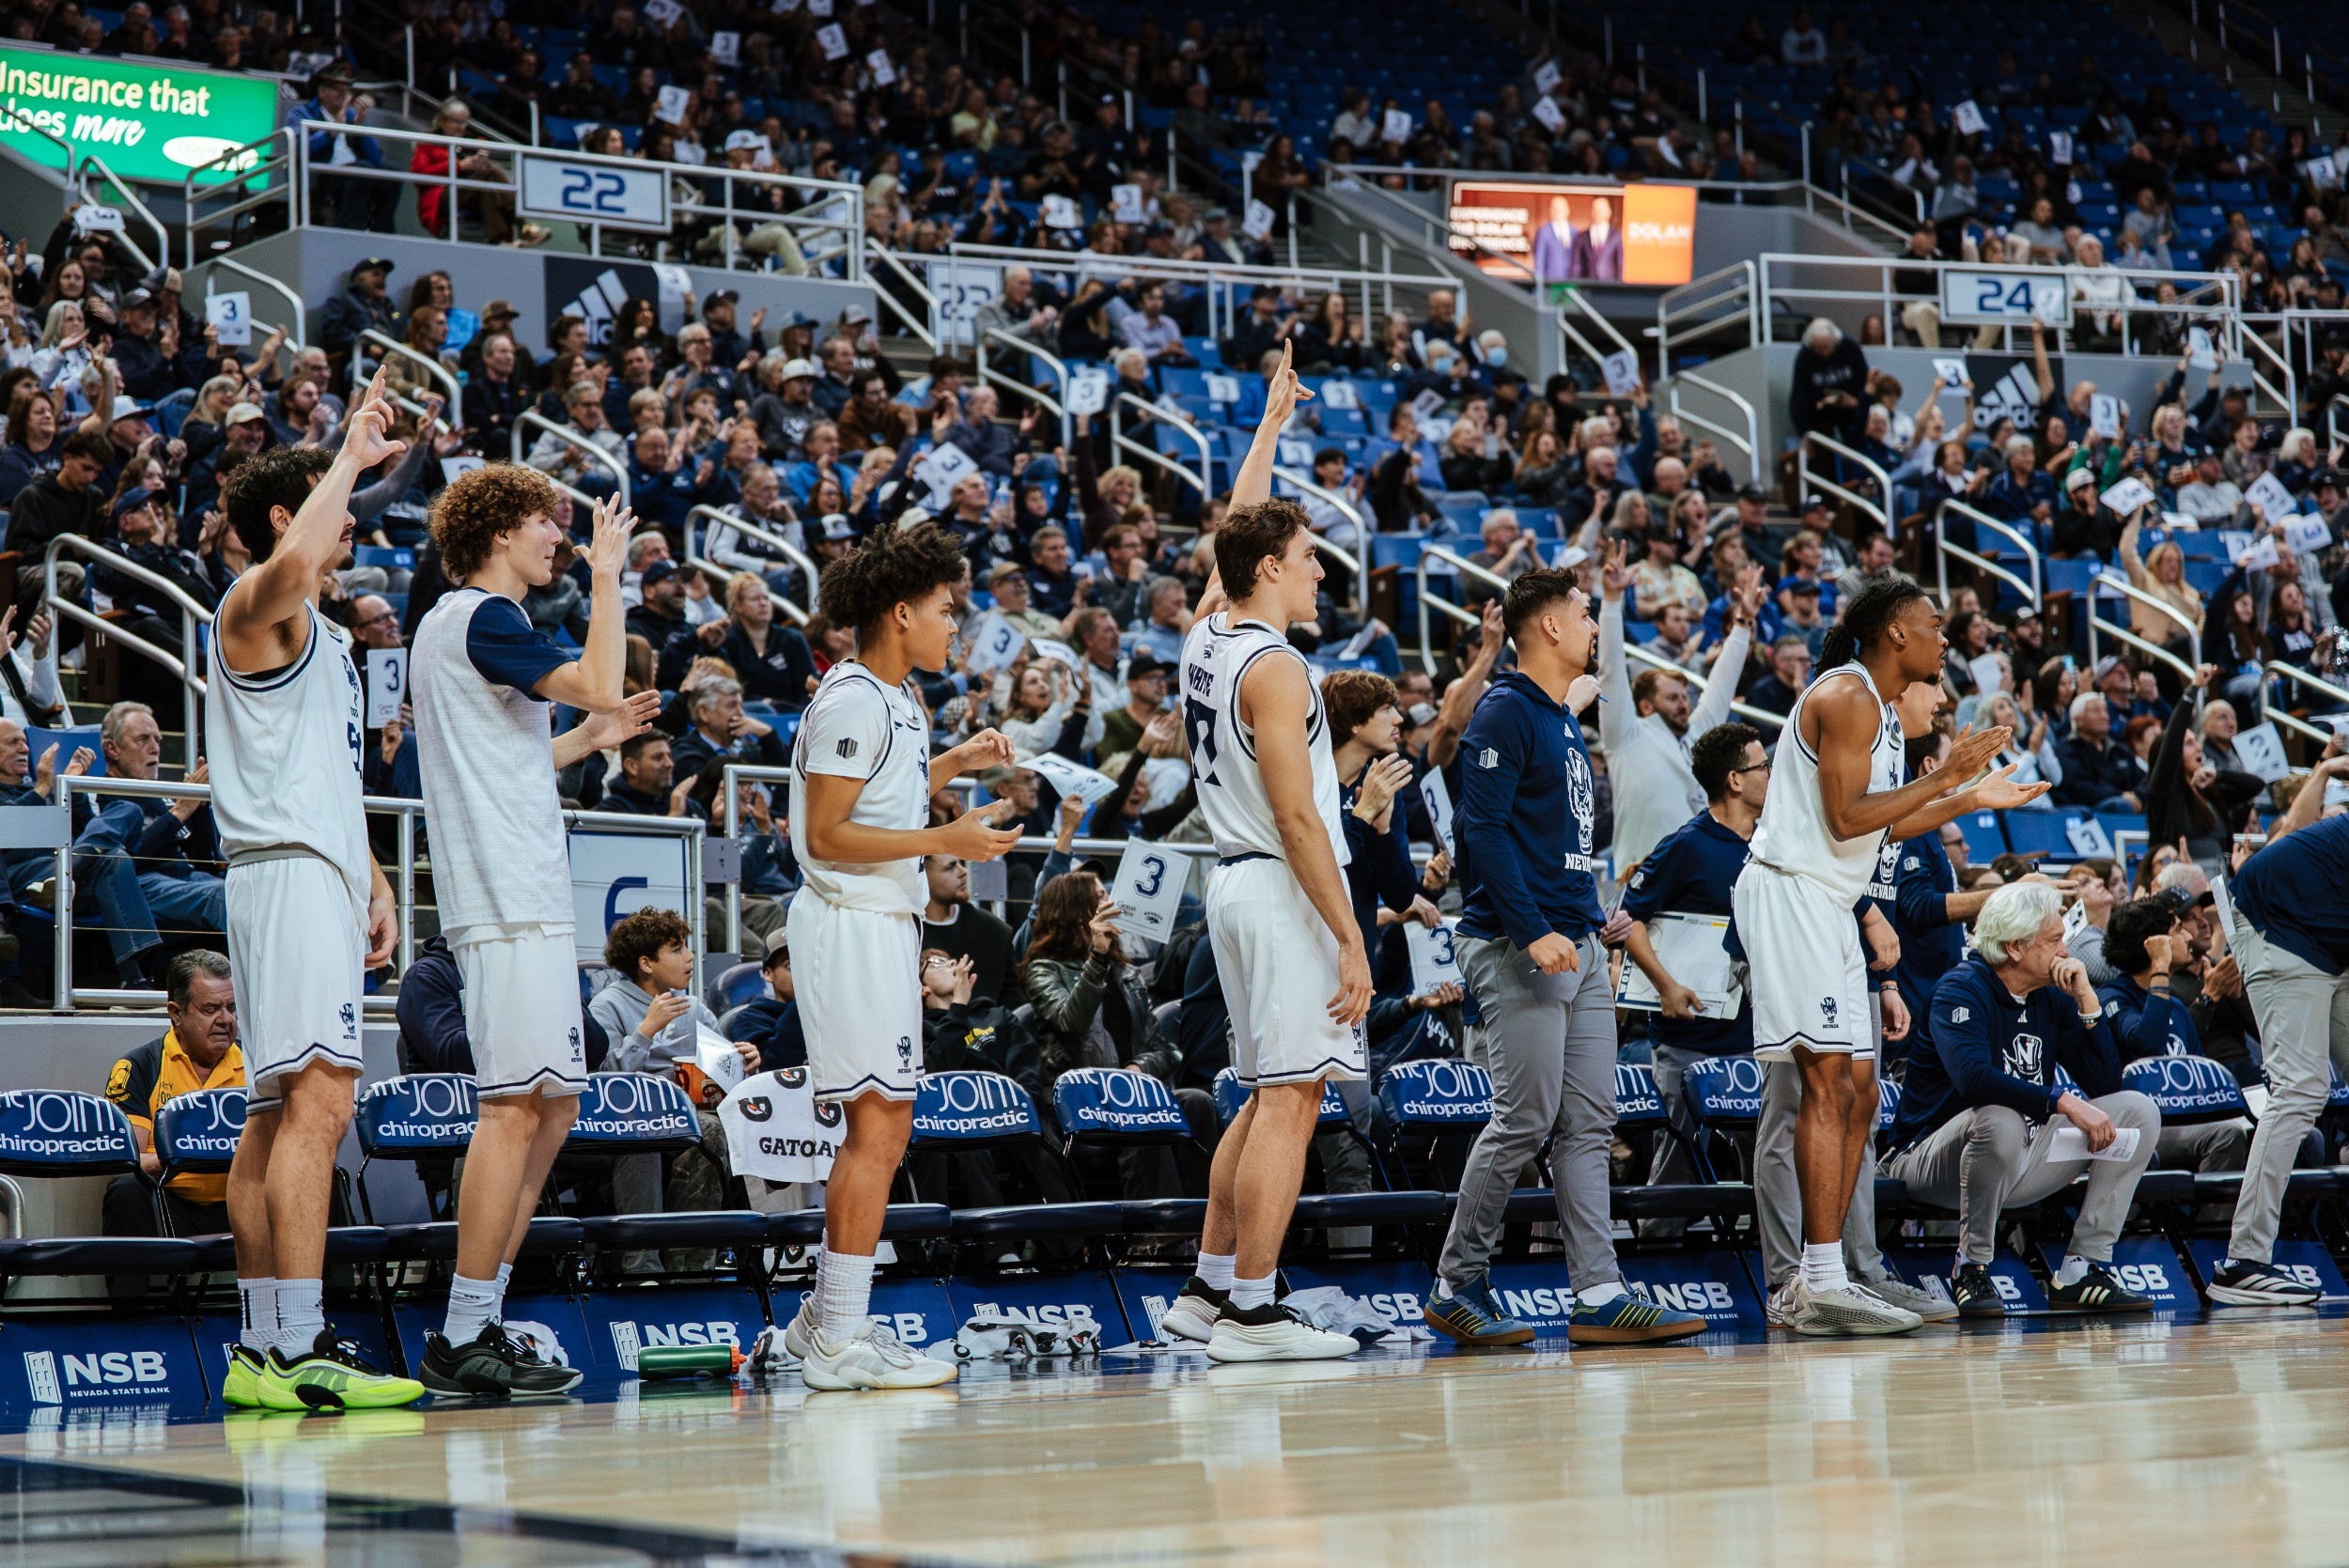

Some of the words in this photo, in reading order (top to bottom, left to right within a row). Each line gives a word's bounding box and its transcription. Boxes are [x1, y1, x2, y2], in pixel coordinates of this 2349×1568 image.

[0, 60, 144, 109] Insurance
[148, 78, 210, 117] that
[70, 114, 146, 147] more
[562, 168, 627, 213] 22
[1978, 279, 2034, 313] 24
[221, 300, 237, 321] 3
[941, 455, 963, 472] 3
[994, 628, 1012, 654] 3
[385, 660, 399, 691] 3
[1424, 787, 1439, 823] 3
[2080, 830, 2100, 852] 3
[1564, 853, 1593, 873] NEVA
[1133, 853, 1167, 900] 3
[1116, 901, 1137, 912] Great
[1429, 924, 1455, 969] 3
[1403, 1098, 1495, 1119] chiropracti
[1704, 1094, 1762, 1112] chiropr
[912, 1110, 1030, 1134] chiropractic
[1078, 1106, 1182, 1127] chiropractic
[1652, 1281, 1734, 1311] NSB
[63, 1351, 167, 1385] NSB
[143, 1386, 170, 1394] BANK
